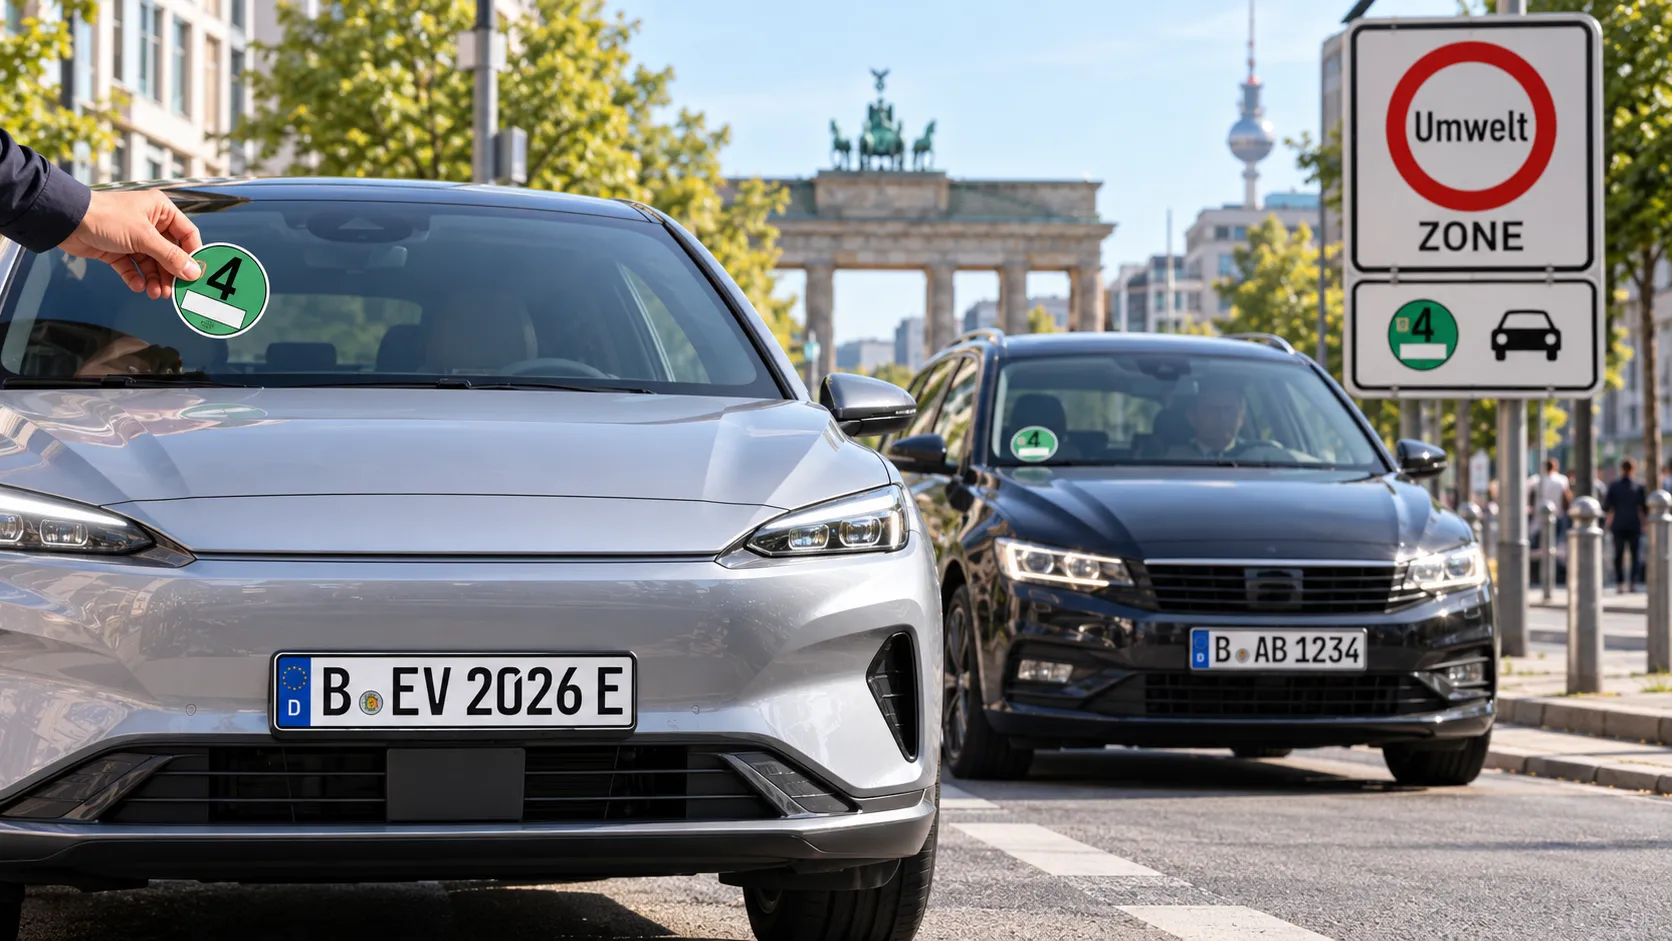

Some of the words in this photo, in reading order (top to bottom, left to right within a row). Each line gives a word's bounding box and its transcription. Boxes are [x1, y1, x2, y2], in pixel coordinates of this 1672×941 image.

[1415, 110, 1528, 142] Umwelt
[1418, 221, 1524, 251] ZONE
[206, 257, 243, 301] 4
[1412, 307, 1434, 342] 4
[1028, 431, 1041, 448] 4
[1197, 653, 1204, 662] D
[1215, 636, 1231, 663] B
[1254, 636, 1287, 663] AB
[1295, 636, 1359, 663] 1234
[322, 667, 351, 716] B
[392, 667, 451, 716] EV
[466, 667, 583, 716] 2026
[597, 667, 623, 716] E
[288, 699, 300, 716] D
